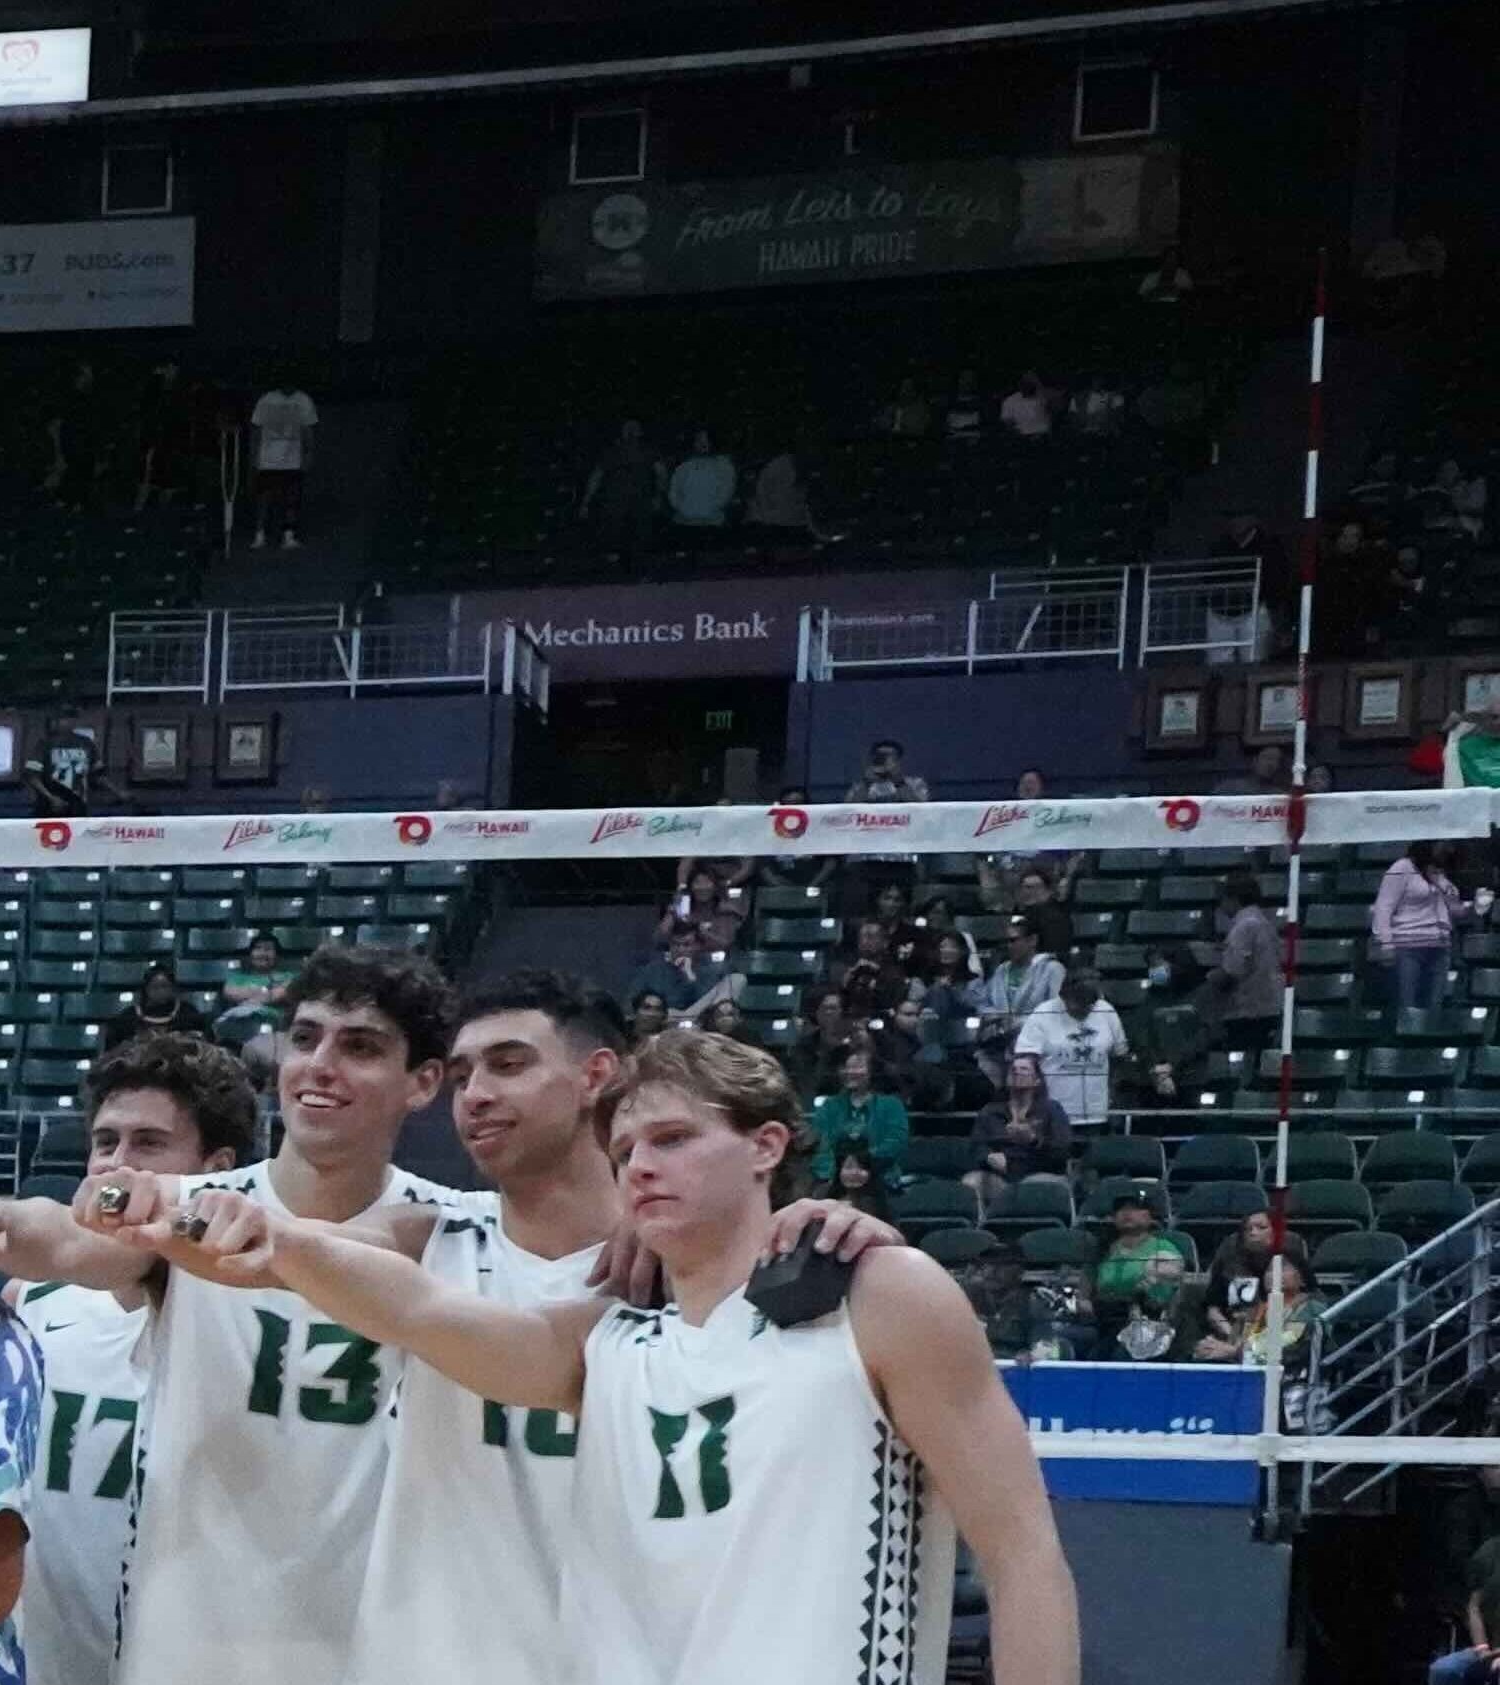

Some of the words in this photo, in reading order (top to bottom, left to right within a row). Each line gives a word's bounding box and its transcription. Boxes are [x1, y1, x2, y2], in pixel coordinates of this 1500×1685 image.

[523, 620, 684, 649] Mechanics
[694, 612, 770, 642] Bank
[248, 1309, 382, 1425] 13
[47, 1391, 138, 1499] 17
[648, 1397, 736, 1519] 11
